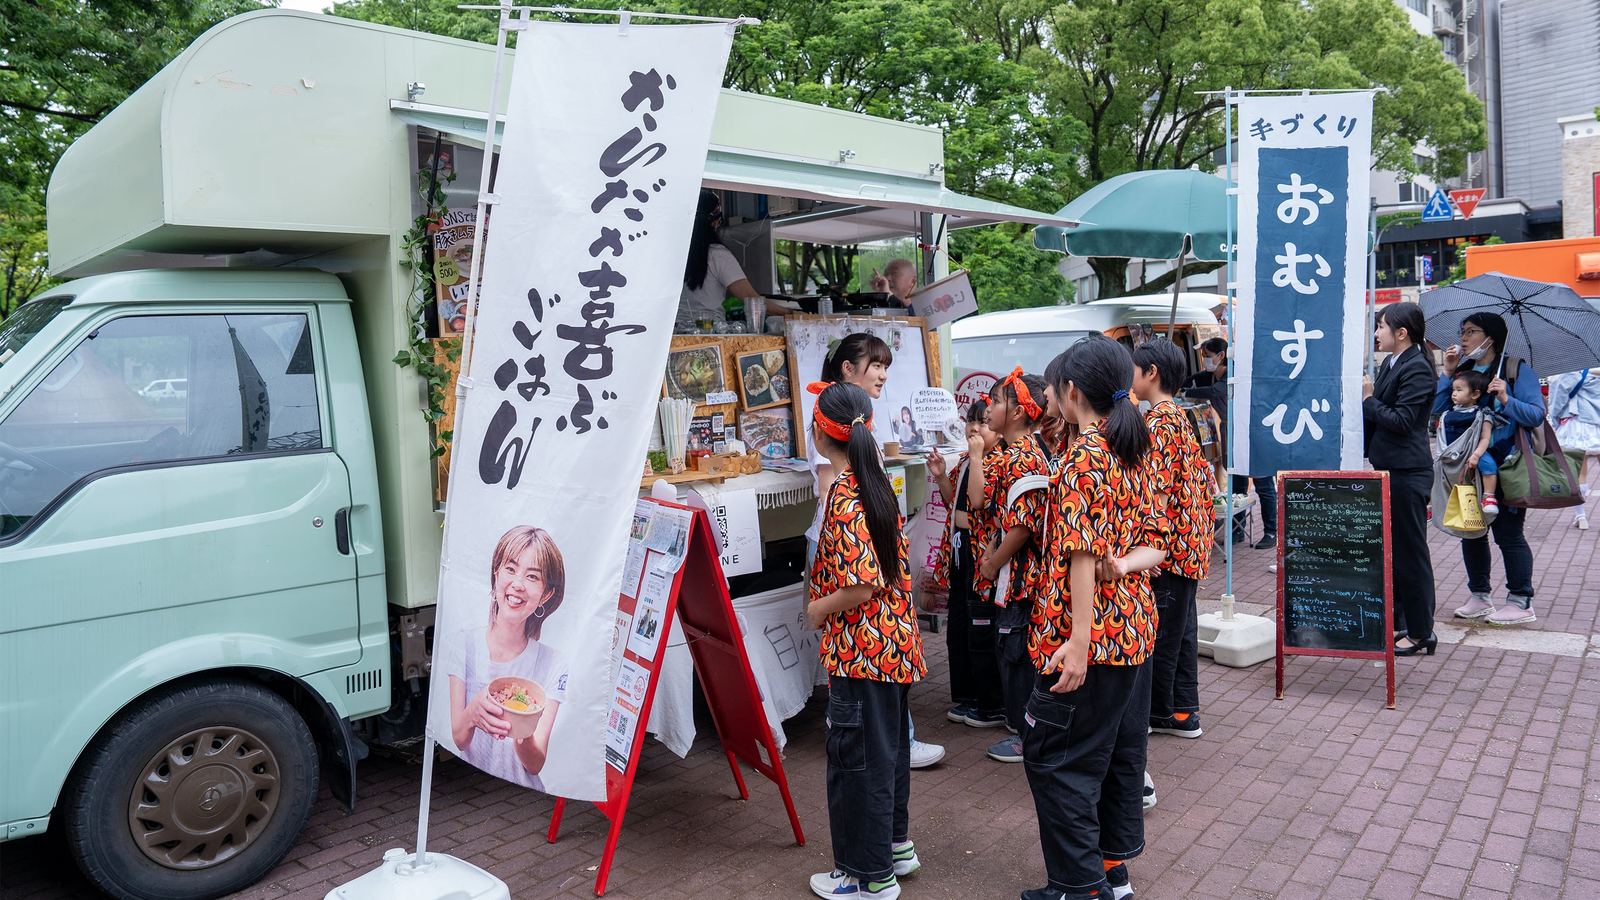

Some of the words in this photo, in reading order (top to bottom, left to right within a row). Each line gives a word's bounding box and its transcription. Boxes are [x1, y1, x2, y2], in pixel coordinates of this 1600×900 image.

[1250, 113, 1357, 141] 手づくり
[556, 67, 677, 435] からだが喜ぶ
[1262, 172, 1334, 445] おむすび
[478, 287, 561, 490] ごはん
[722, 554, 739, 566] NE
